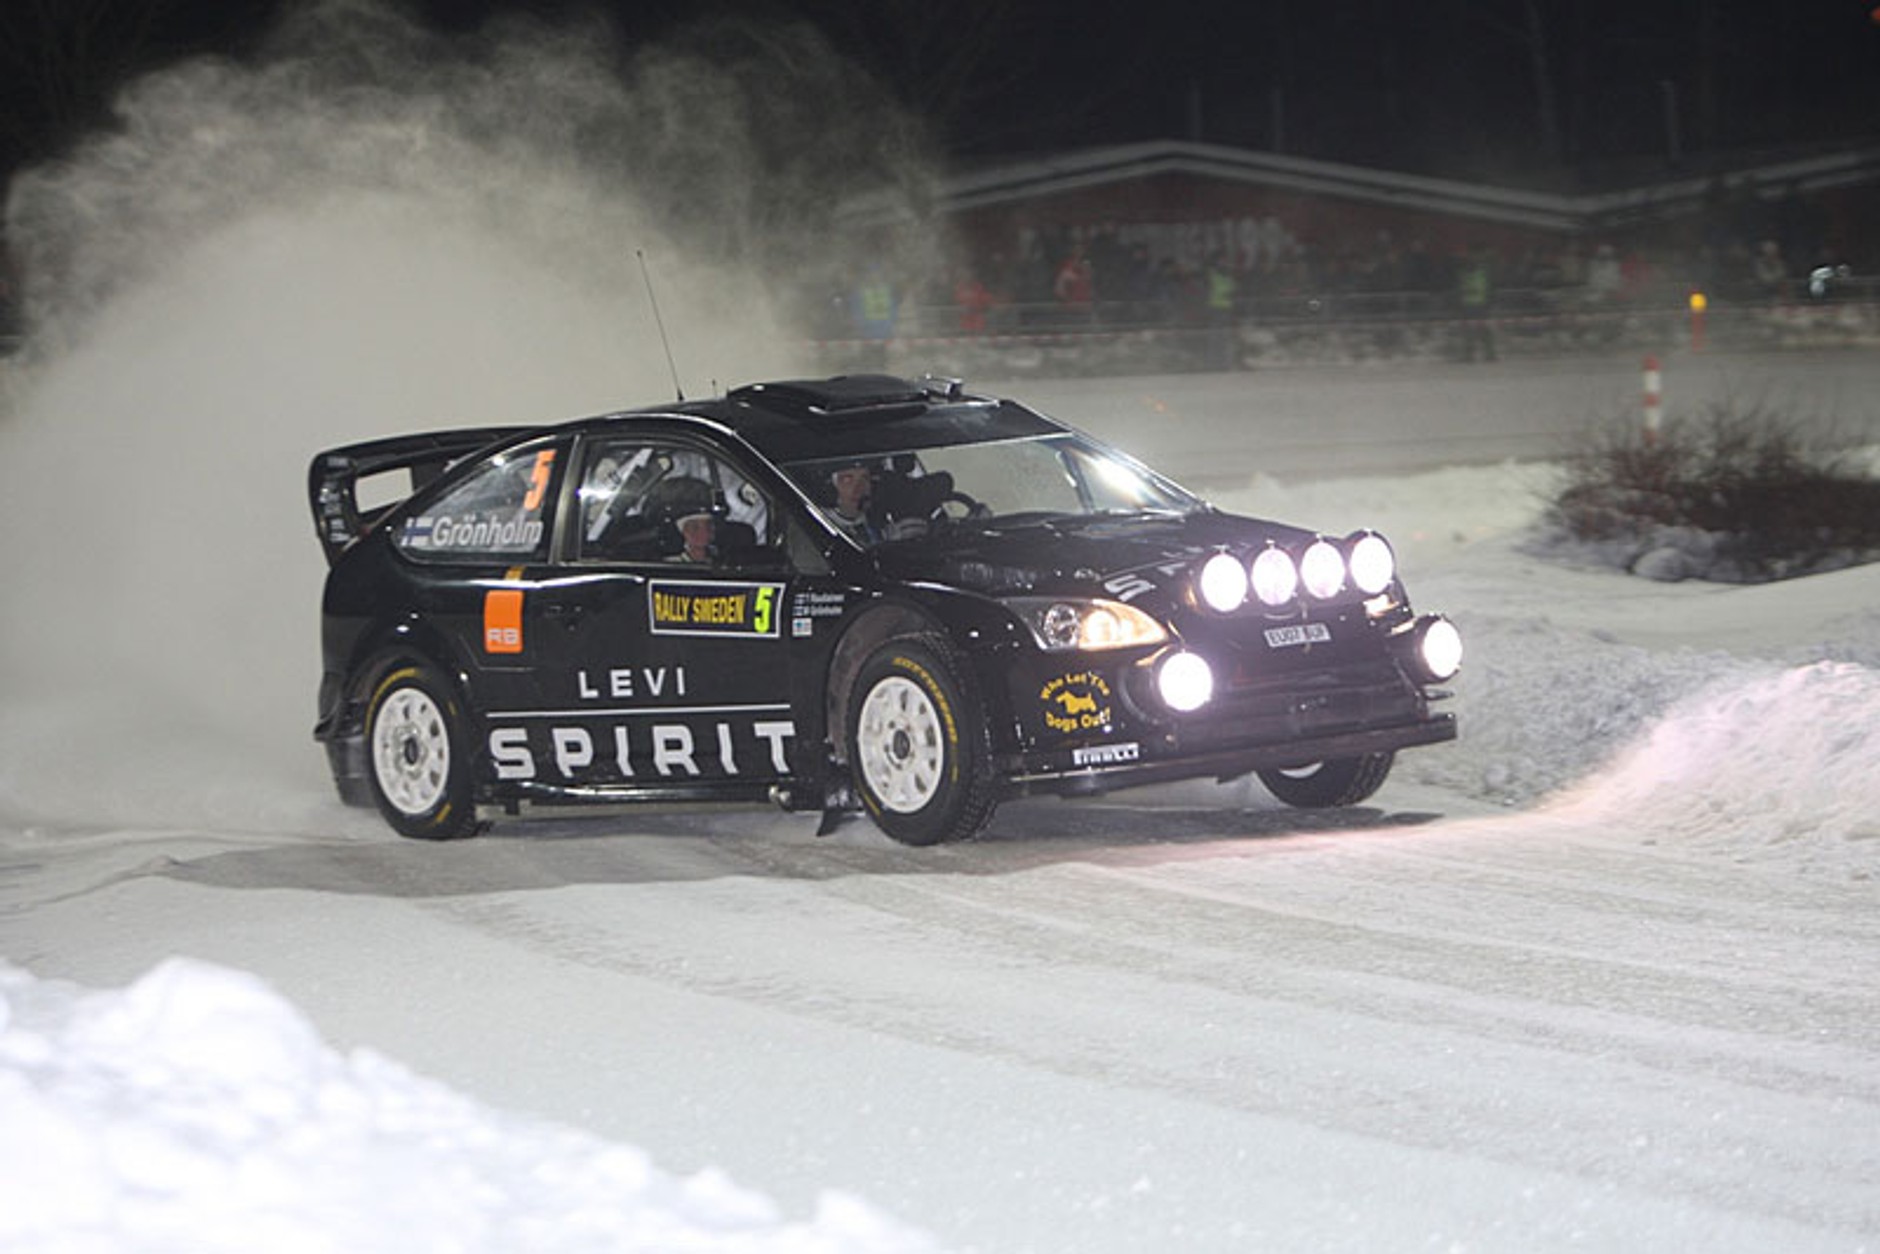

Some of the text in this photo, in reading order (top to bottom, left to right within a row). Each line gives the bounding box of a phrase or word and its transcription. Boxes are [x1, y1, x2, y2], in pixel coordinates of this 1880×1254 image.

[523, 449, 557, 511] 5
[431, 514, 544, 547] Grönholm
[653, 586, 774, 633] RALLY SWEDEN 5
[487, 628, 519, 645] RB
[578, 666, 686, 699] LEVI
[1065, 673, 1087, 685] Let
[1045, 711, 1078, 733] Dogs
[489, 720, 797, 779] SPIRIT
